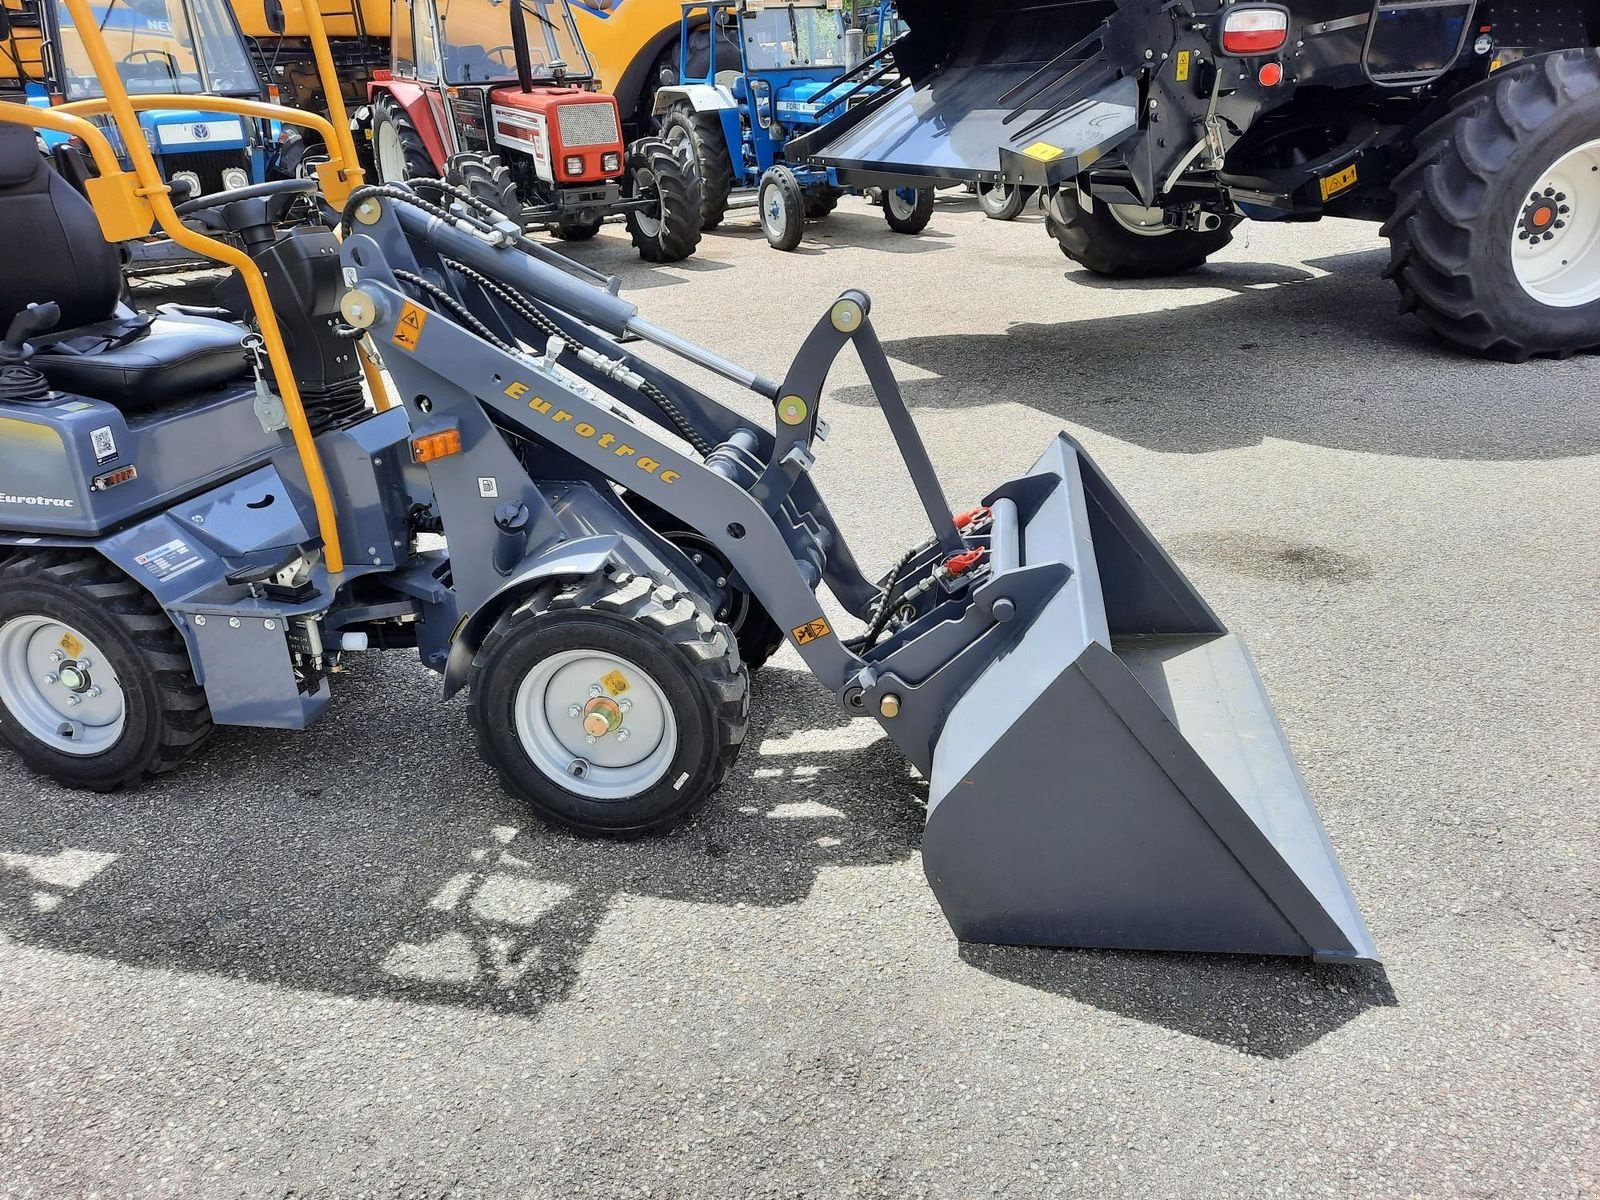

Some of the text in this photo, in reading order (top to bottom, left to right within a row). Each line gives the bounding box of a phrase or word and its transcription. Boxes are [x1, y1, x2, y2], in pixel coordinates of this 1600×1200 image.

[786, 102, 801, 111] FORD
[503, 381, 682, 484] Eurotrac
[0, 492, 74, 507] Eurotrac
